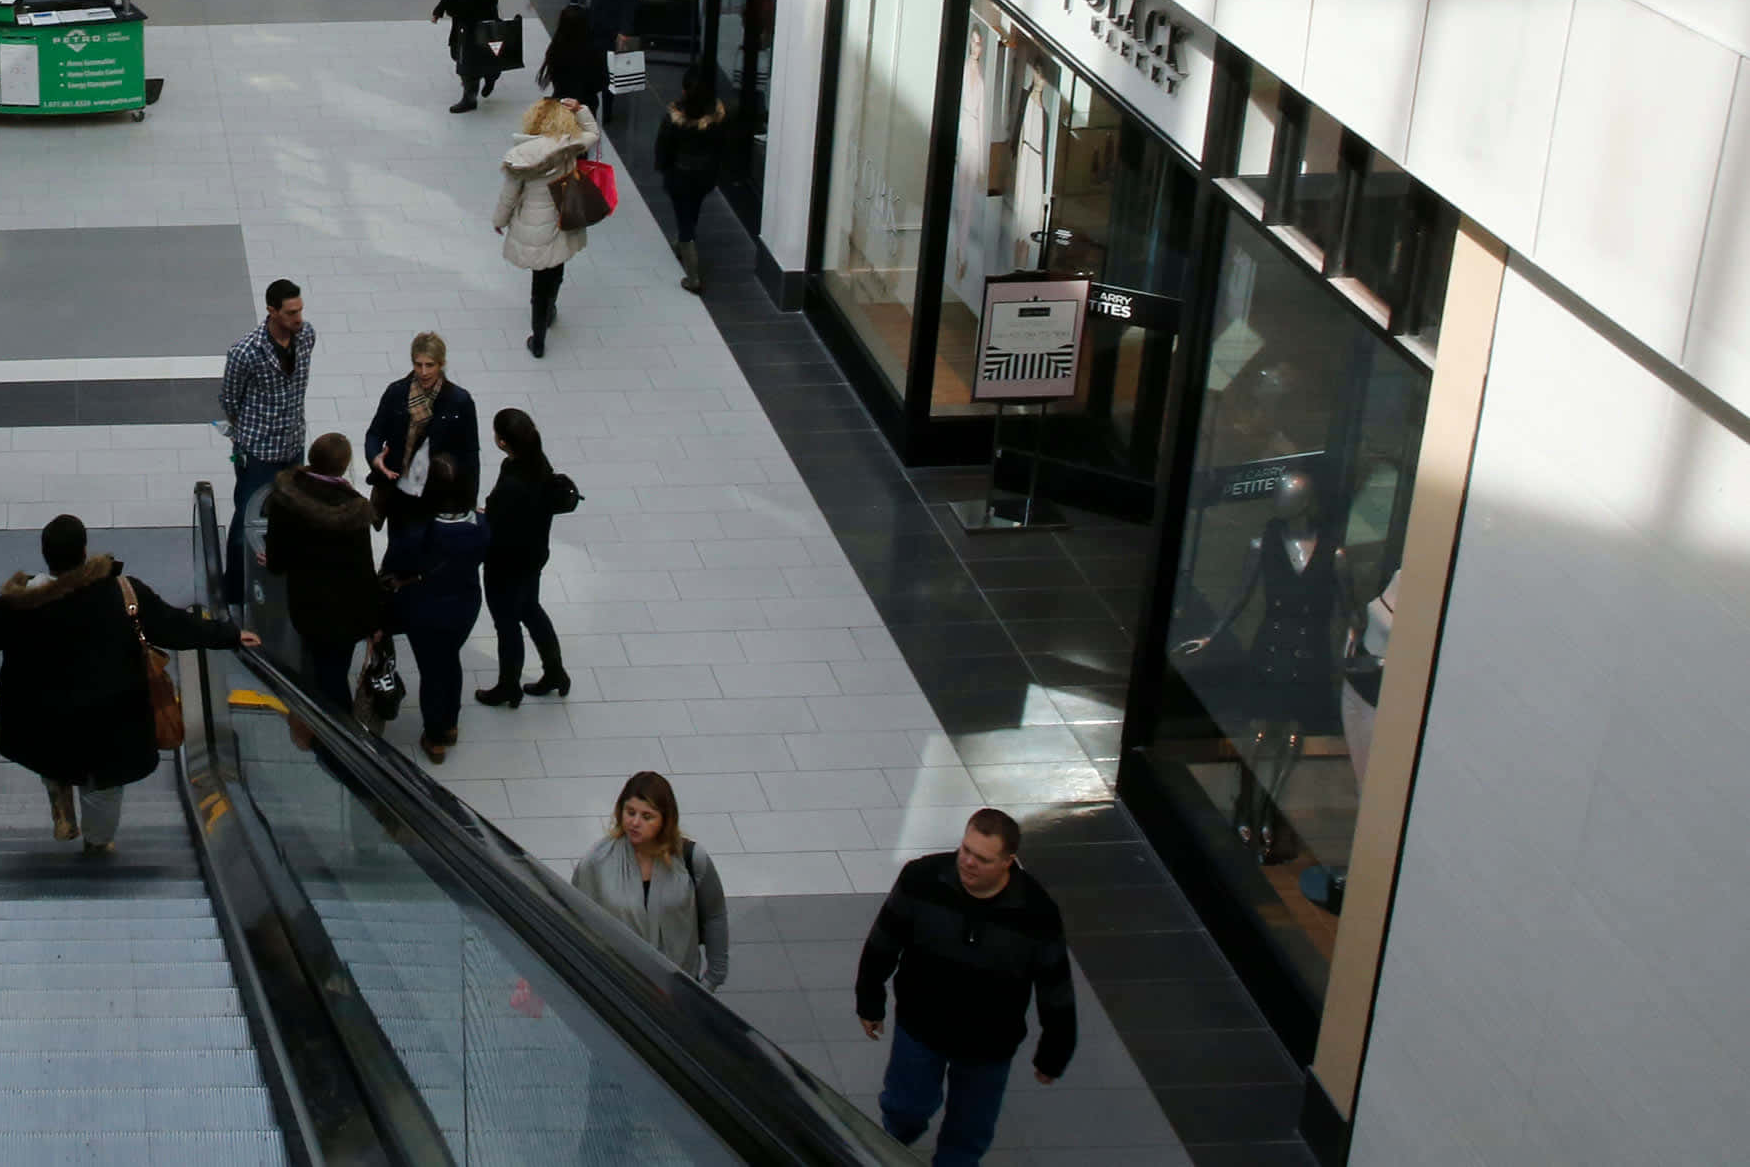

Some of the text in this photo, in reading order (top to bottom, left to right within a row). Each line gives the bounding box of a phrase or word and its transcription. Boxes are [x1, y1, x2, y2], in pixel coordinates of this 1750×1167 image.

[52, 35, 101, 44] PETRO
[1089, 299, 1132, 319] TITES
[1223, 476, 1281, 496] PETITE
